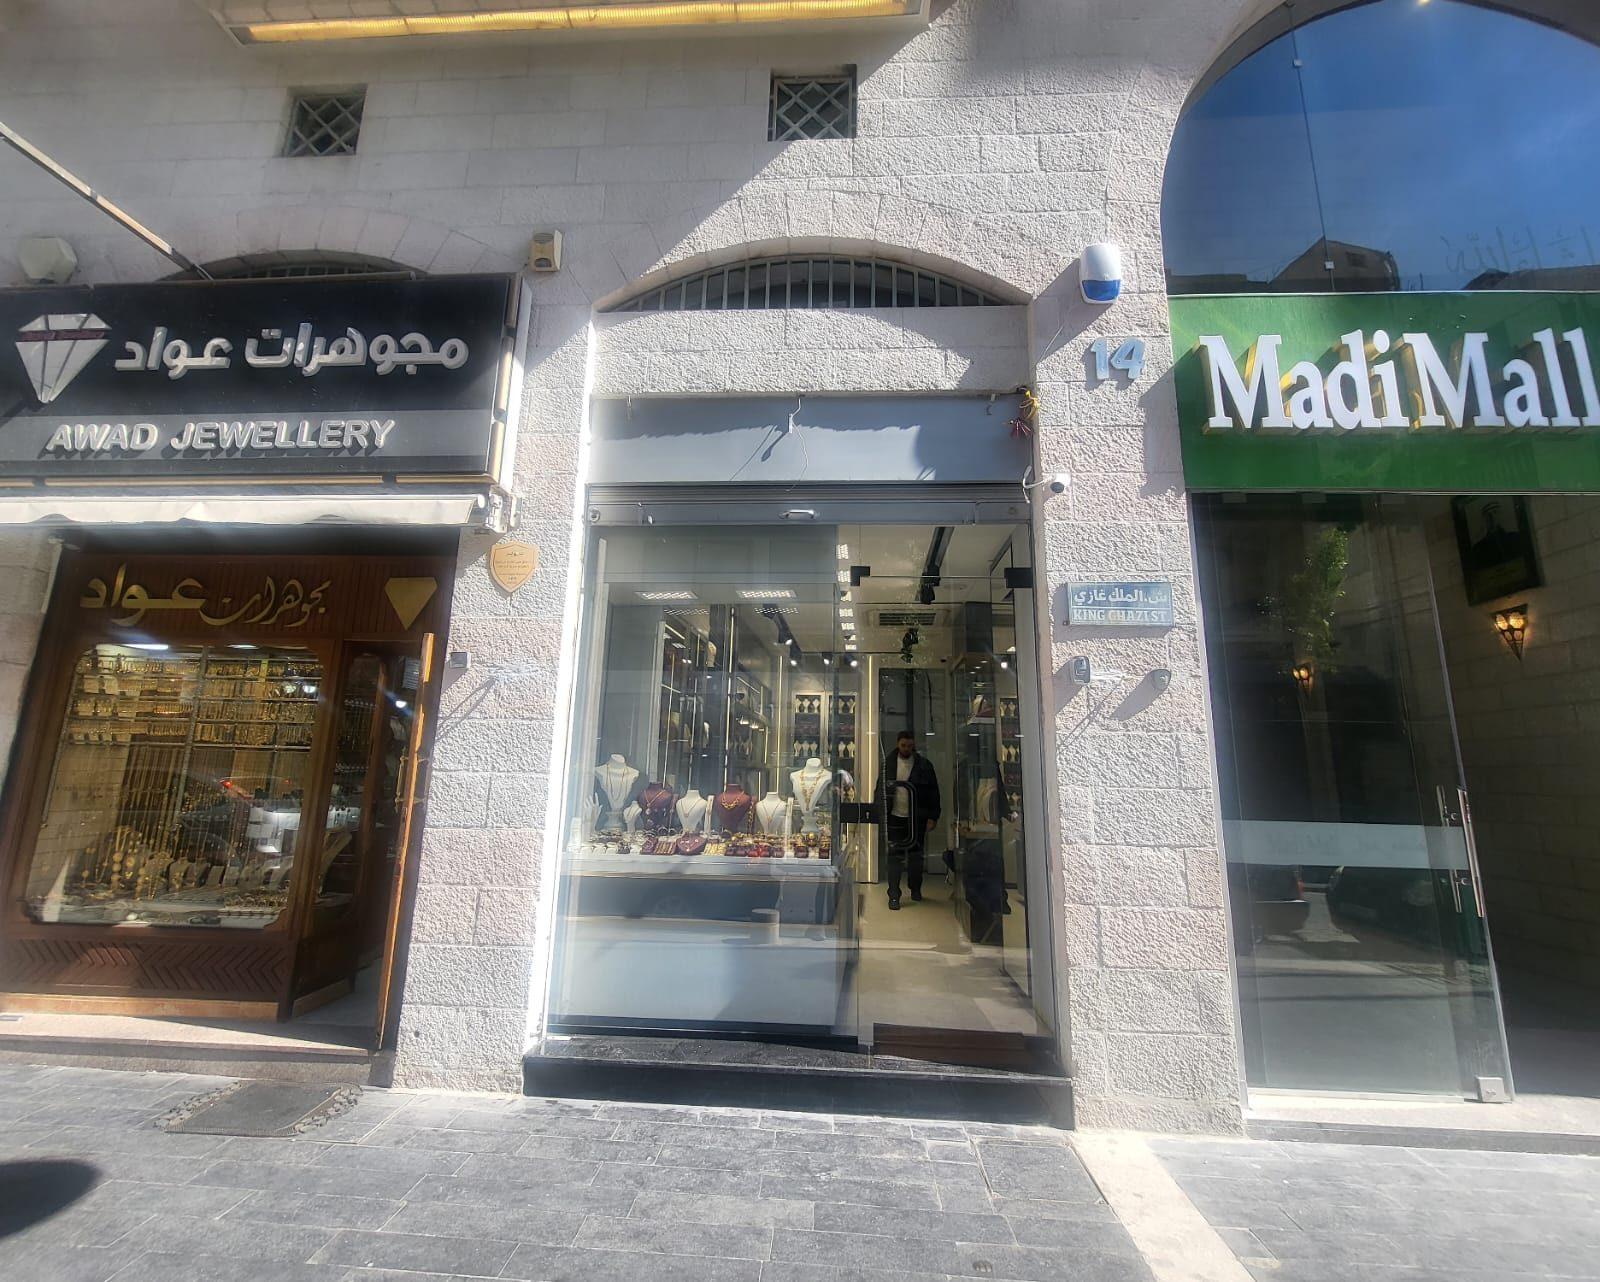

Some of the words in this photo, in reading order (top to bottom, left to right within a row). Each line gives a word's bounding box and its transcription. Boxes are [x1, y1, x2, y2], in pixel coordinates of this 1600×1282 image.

[114, 325, 233, 380] عواد
[245, 322, 469, 376] مجوهرات
[1091, 336, 1146, 380] 14
[45, 422, 159, 452] AWAD
[170, 419, 396, 450] JEWELLERY
[79, 562, 207, 627] عواد
[199, 575, 332, 627] مجوهرات
[1073, 588, 1107, 606] غازي
[1073, 608, 1106, 621] KING
[1107, 609, 1149, 622] GHAZI
